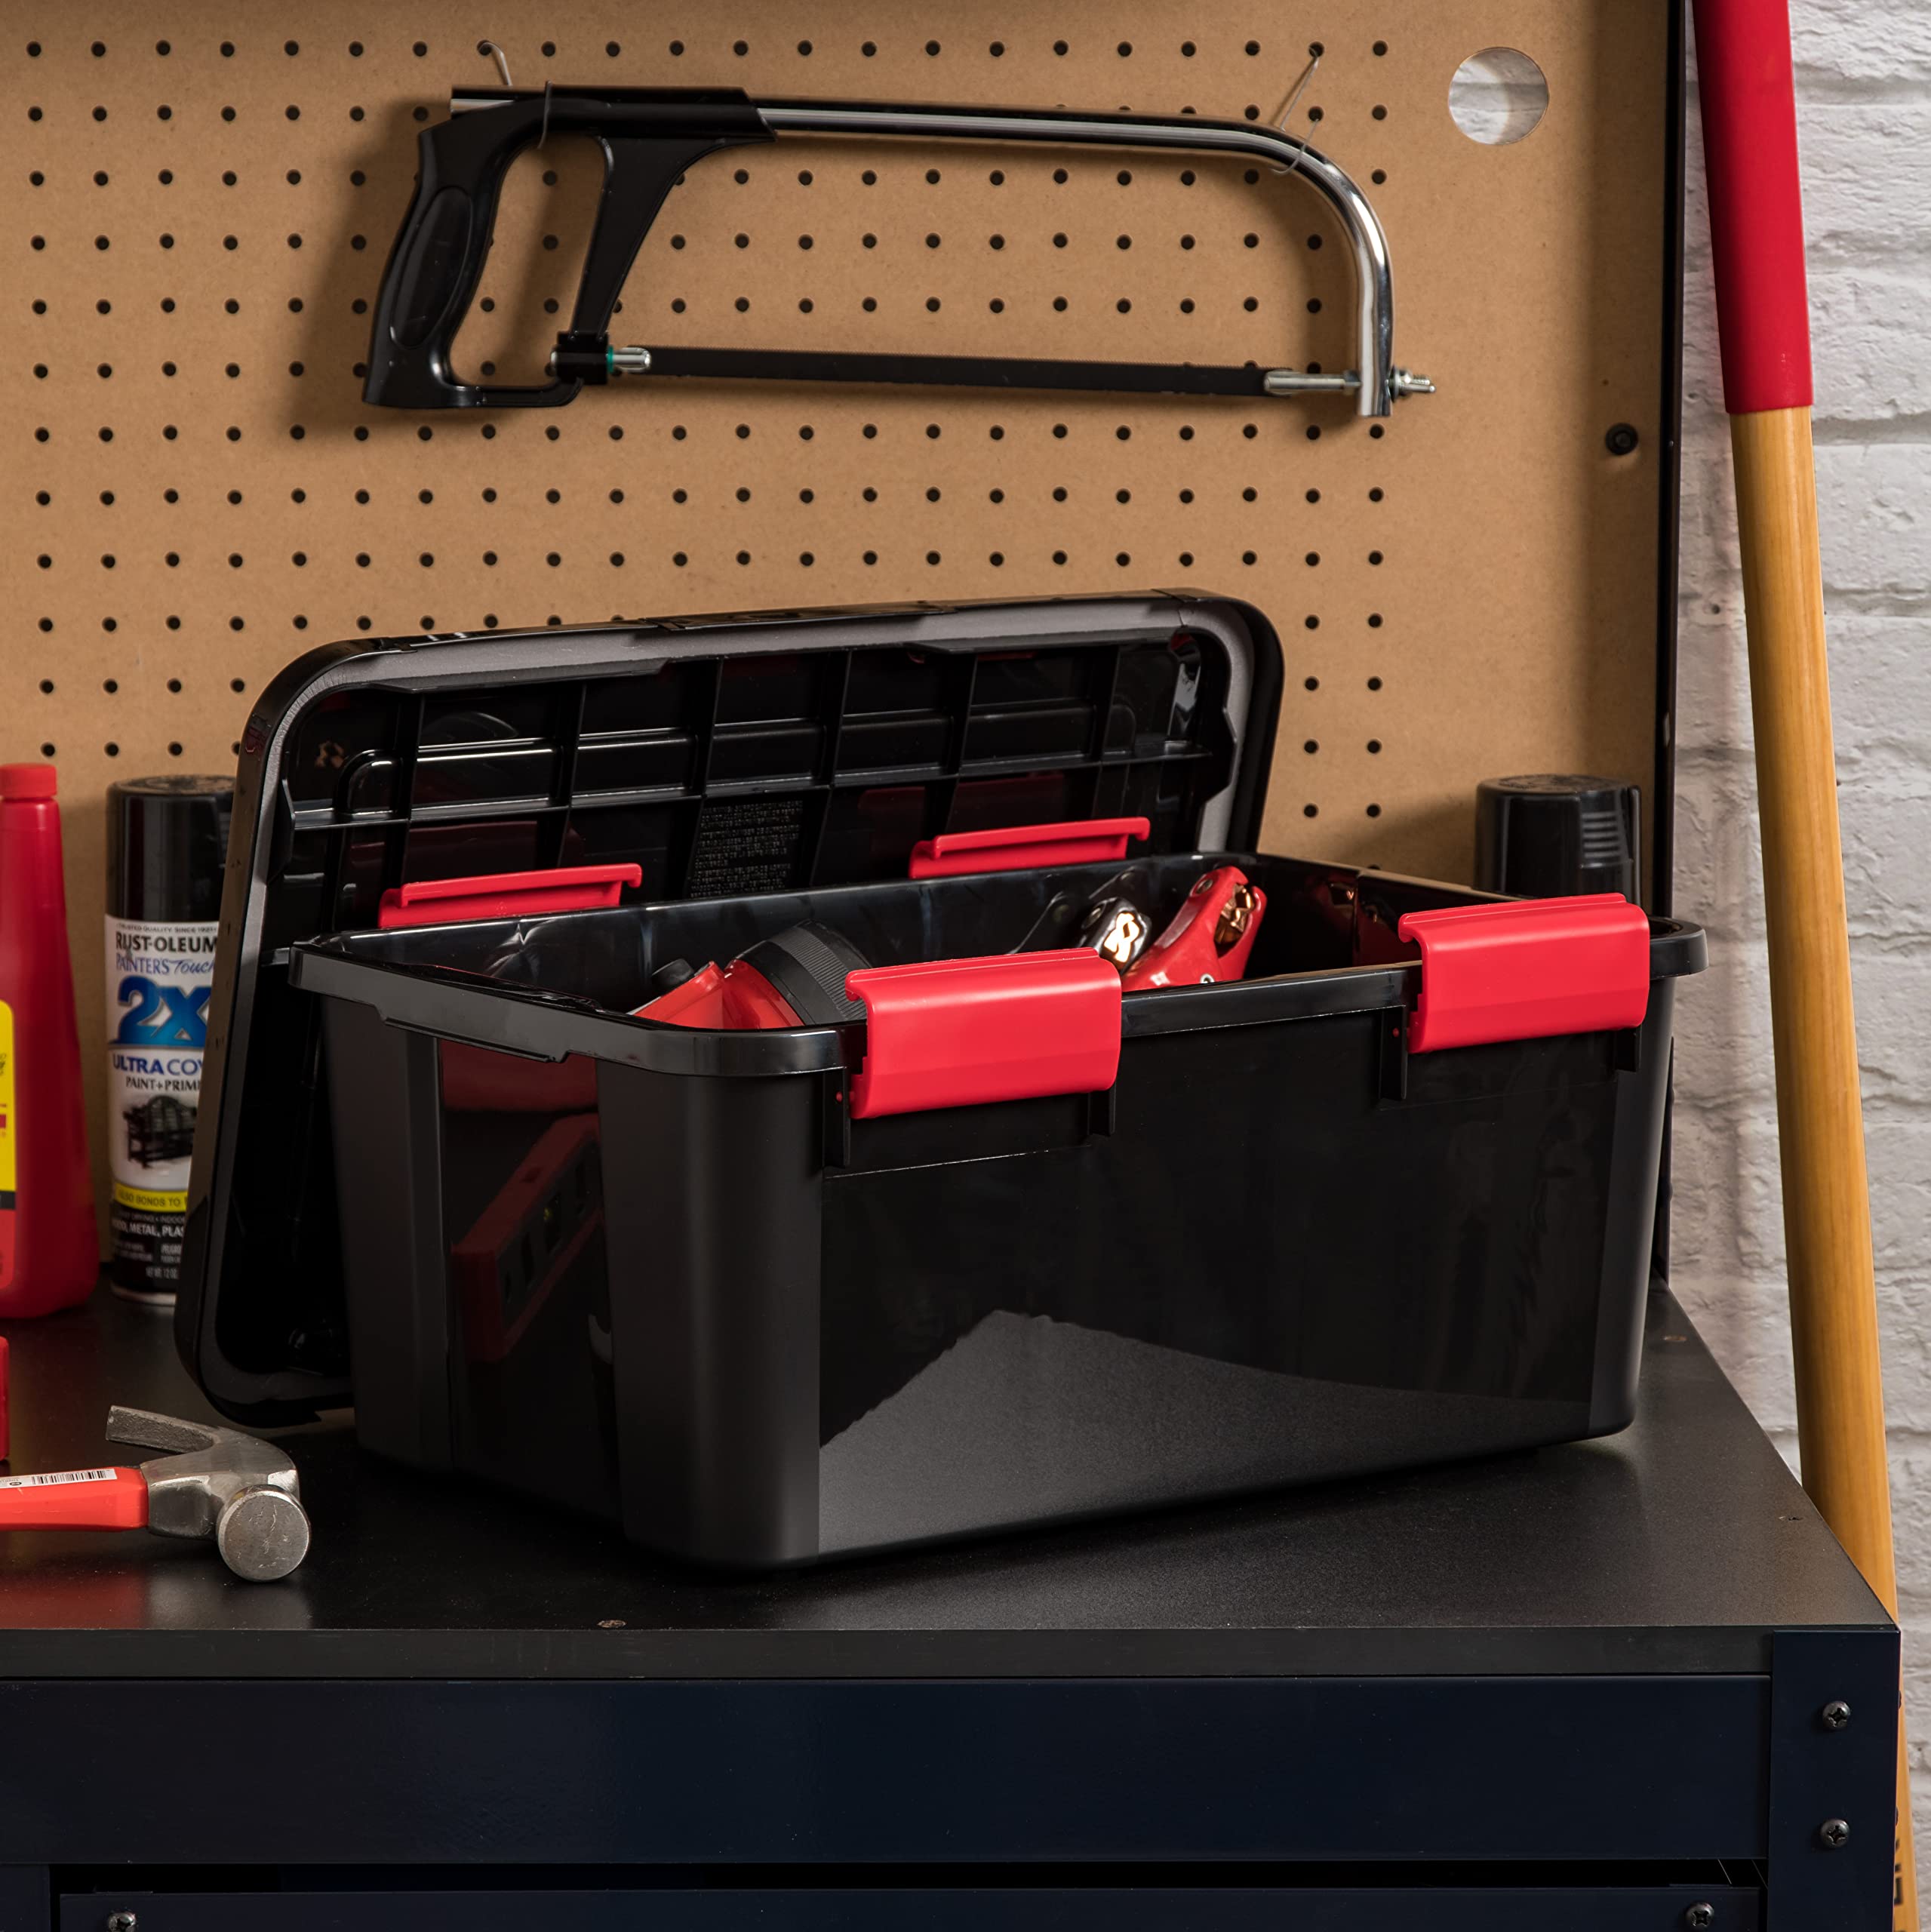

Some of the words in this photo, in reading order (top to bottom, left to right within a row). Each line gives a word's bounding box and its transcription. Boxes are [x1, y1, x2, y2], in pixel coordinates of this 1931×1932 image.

[116, 931, 217, 953] RUST-OLEUM
[116, 953, 170, 974] PAINTER'S
[116, 975, 212, 1048] 2X
[113, 1054, 165, 1075] ULTRA
[136, 1195, 165, 1207] BONDS
[168, 1198, 181, 1207] TO
[130, 1223, 161, 1237] METAL,
